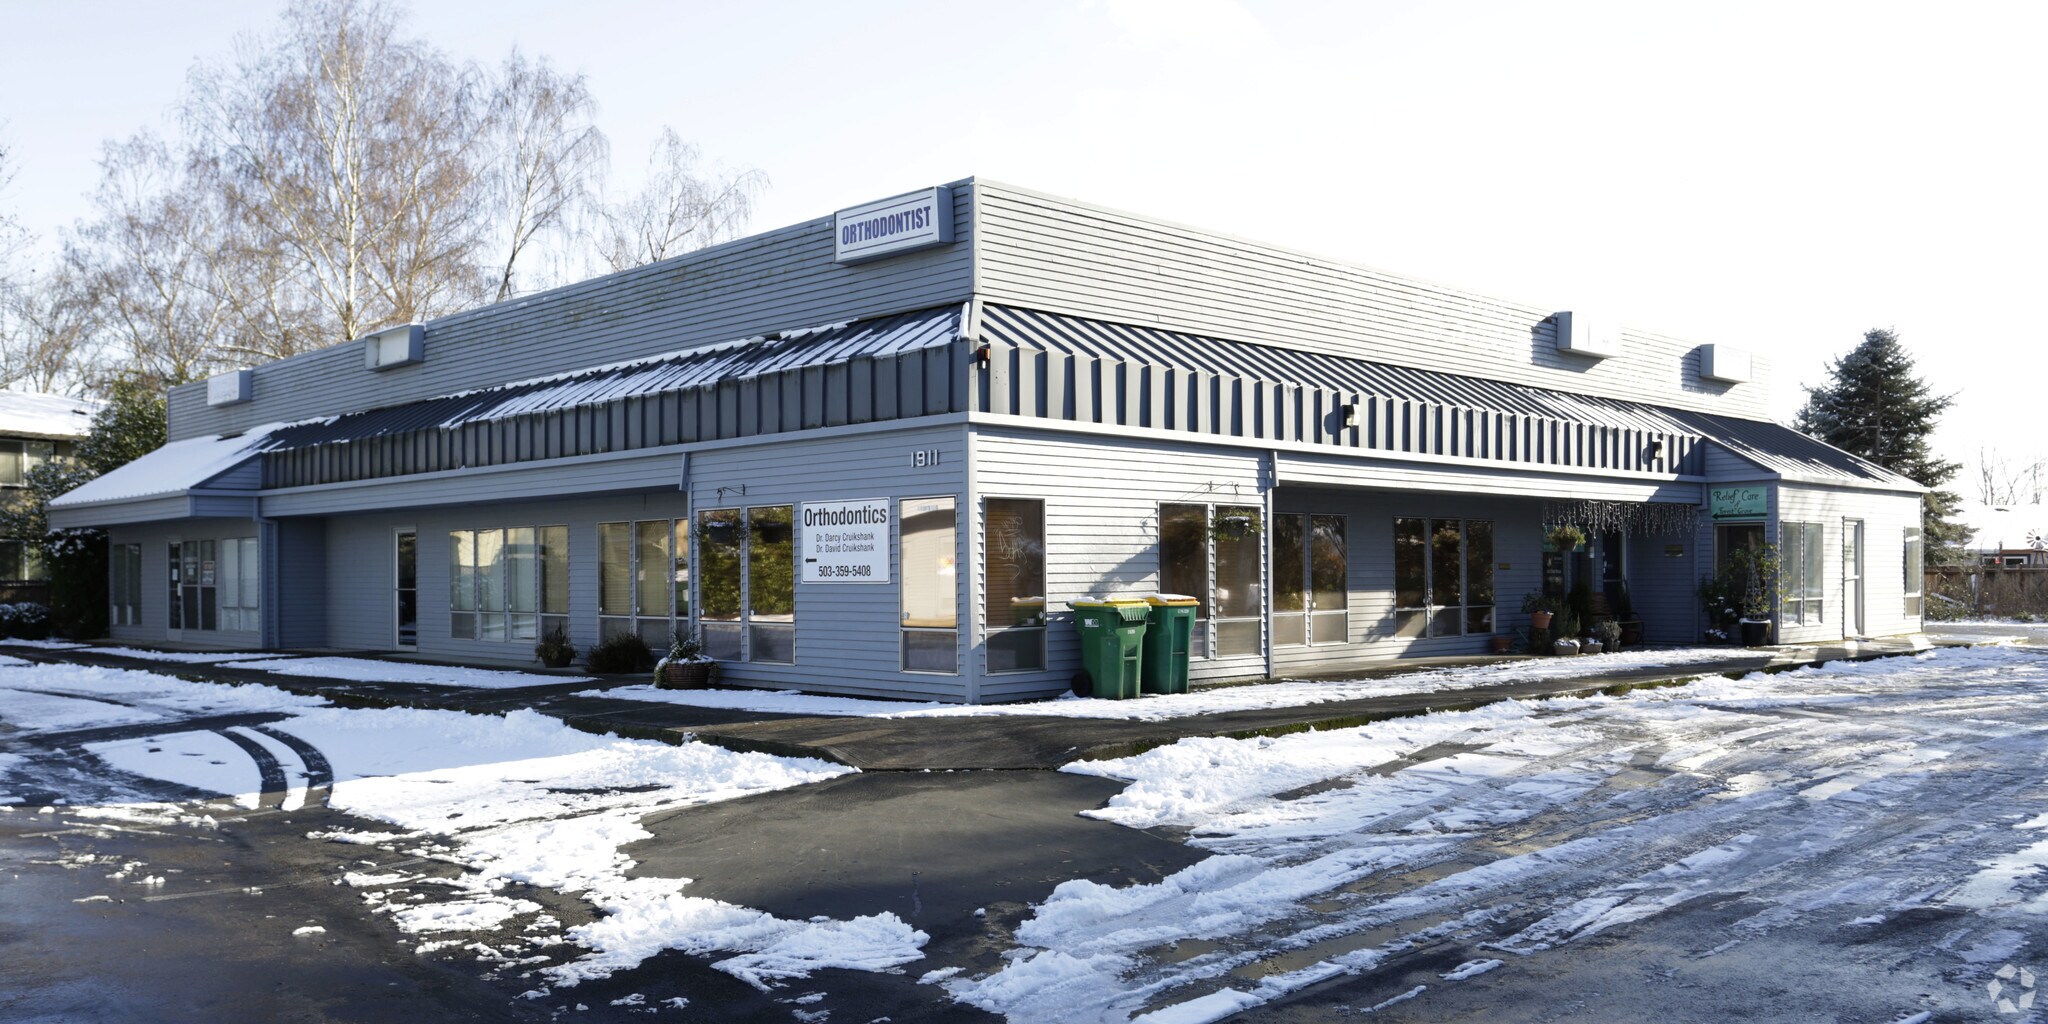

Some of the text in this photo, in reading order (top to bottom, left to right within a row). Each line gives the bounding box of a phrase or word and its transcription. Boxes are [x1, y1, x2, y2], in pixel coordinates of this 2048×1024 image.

[842, 206, 931, 245] ORTHODONTIST
[911, 449, 938, 468] 1911
[1713, 489, 1760, 504] Relief Care
[804, 505, 887, 527] Orthodontics
[825, 533, 841, 543] Darcy
[842, 532, 875, 542] Cruikshank
[825, 544, 841, 553] David
[842, 543, 875, 552] Cruikshank
[818, 565, 872, 577] 503-359-5408
